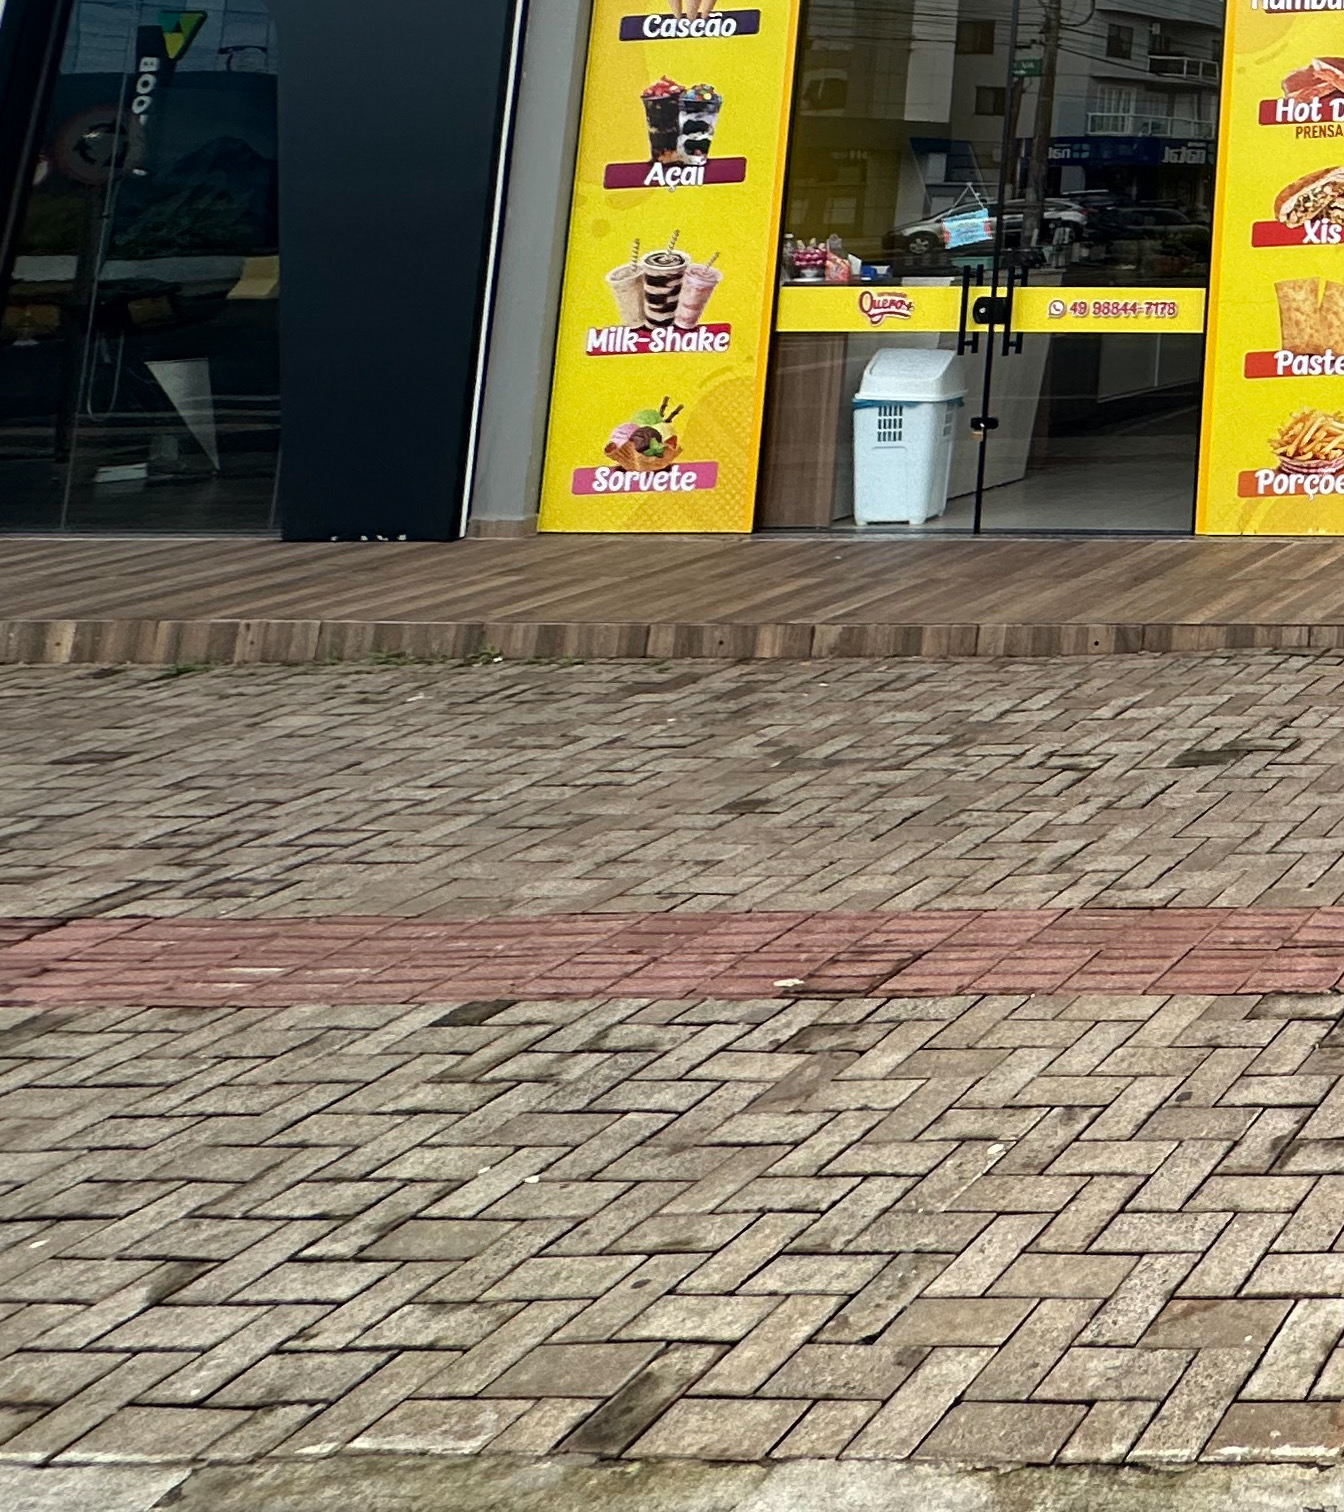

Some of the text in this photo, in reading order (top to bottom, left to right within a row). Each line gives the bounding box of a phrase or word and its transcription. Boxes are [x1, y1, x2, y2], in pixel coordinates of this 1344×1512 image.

[642, 12, 737, 38] Cascão
[1275, 97, 1322, 123] Hot
[644, 157, 705, 191] Açaí
[1302, 218, 1343, 245] Xis
[1069, 301, 1088, 316] 49
[585, 324, 731, 354] Milk-Shake
[592, 464, 698, 493] Sorvete
